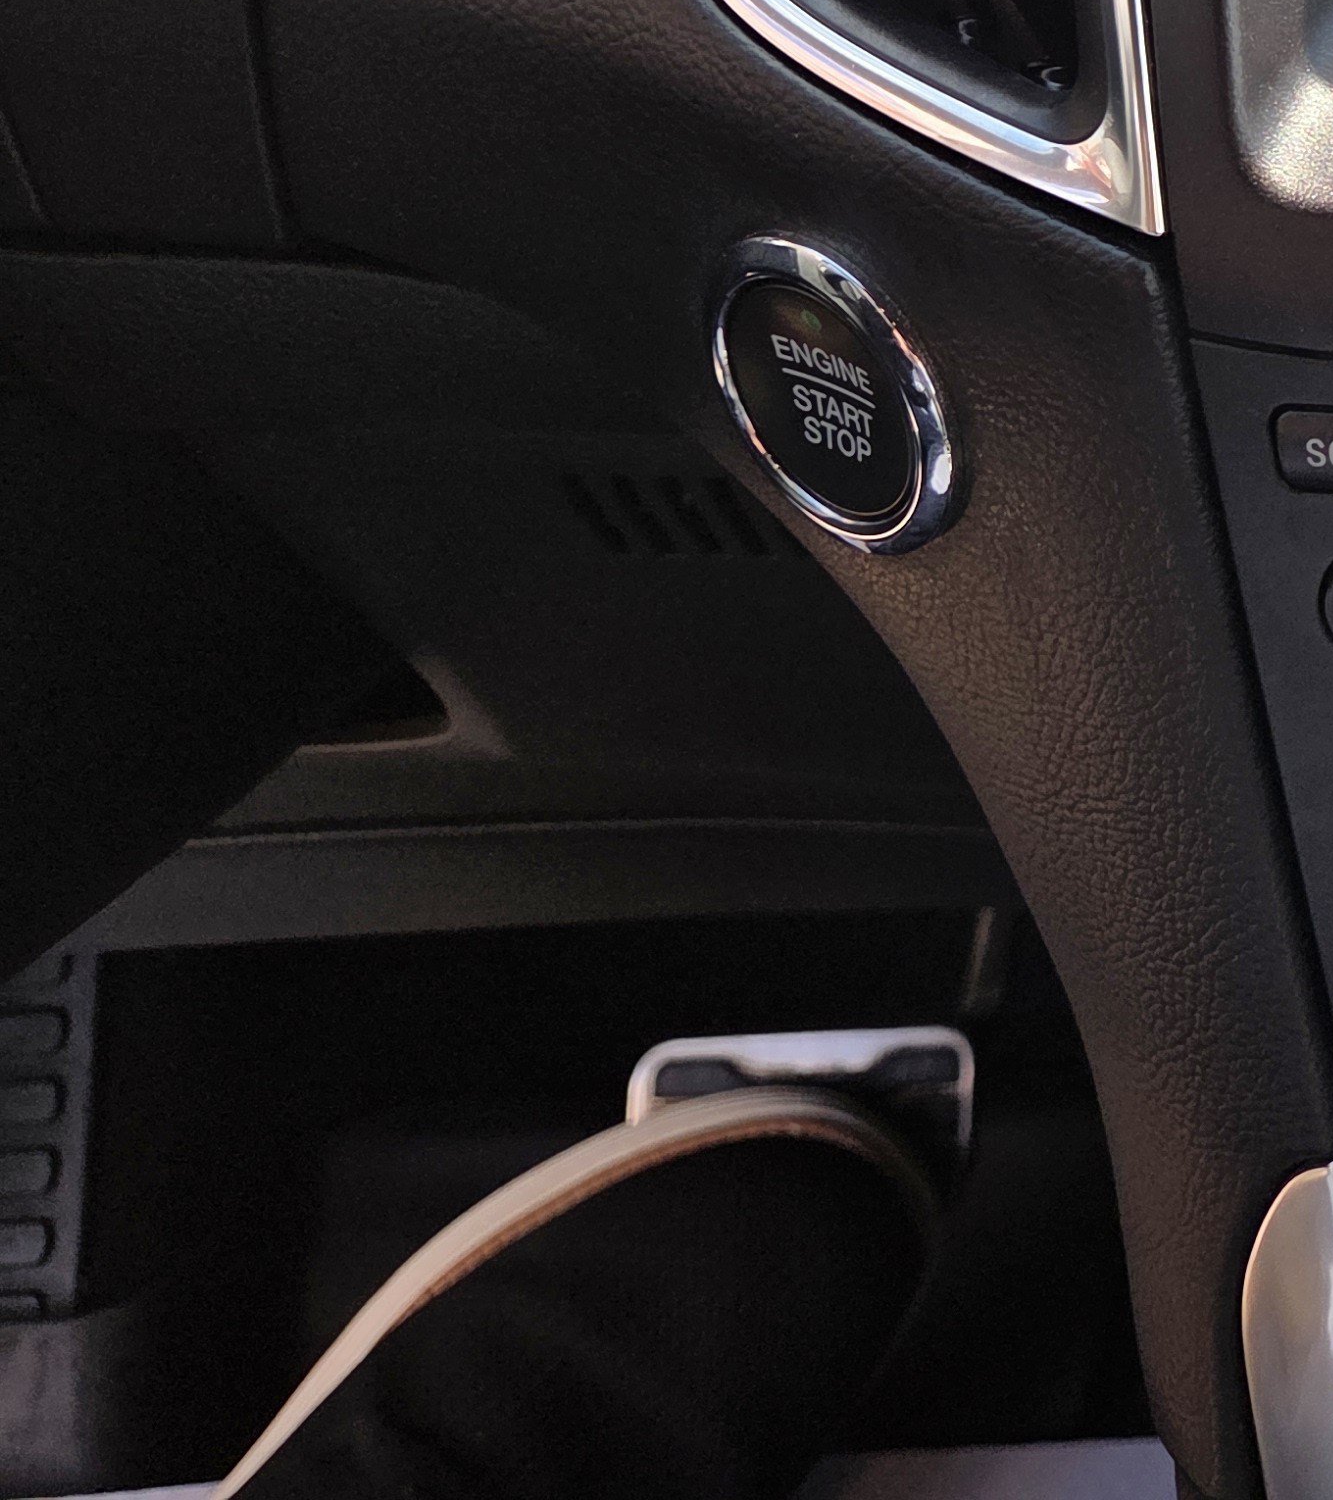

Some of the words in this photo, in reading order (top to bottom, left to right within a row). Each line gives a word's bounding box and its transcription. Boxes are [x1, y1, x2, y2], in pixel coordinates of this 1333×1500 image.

[770, 333, 874, 396] ENGINE
[792, 383, 873, 438] START
[804, 416, 872, 463] STOP
